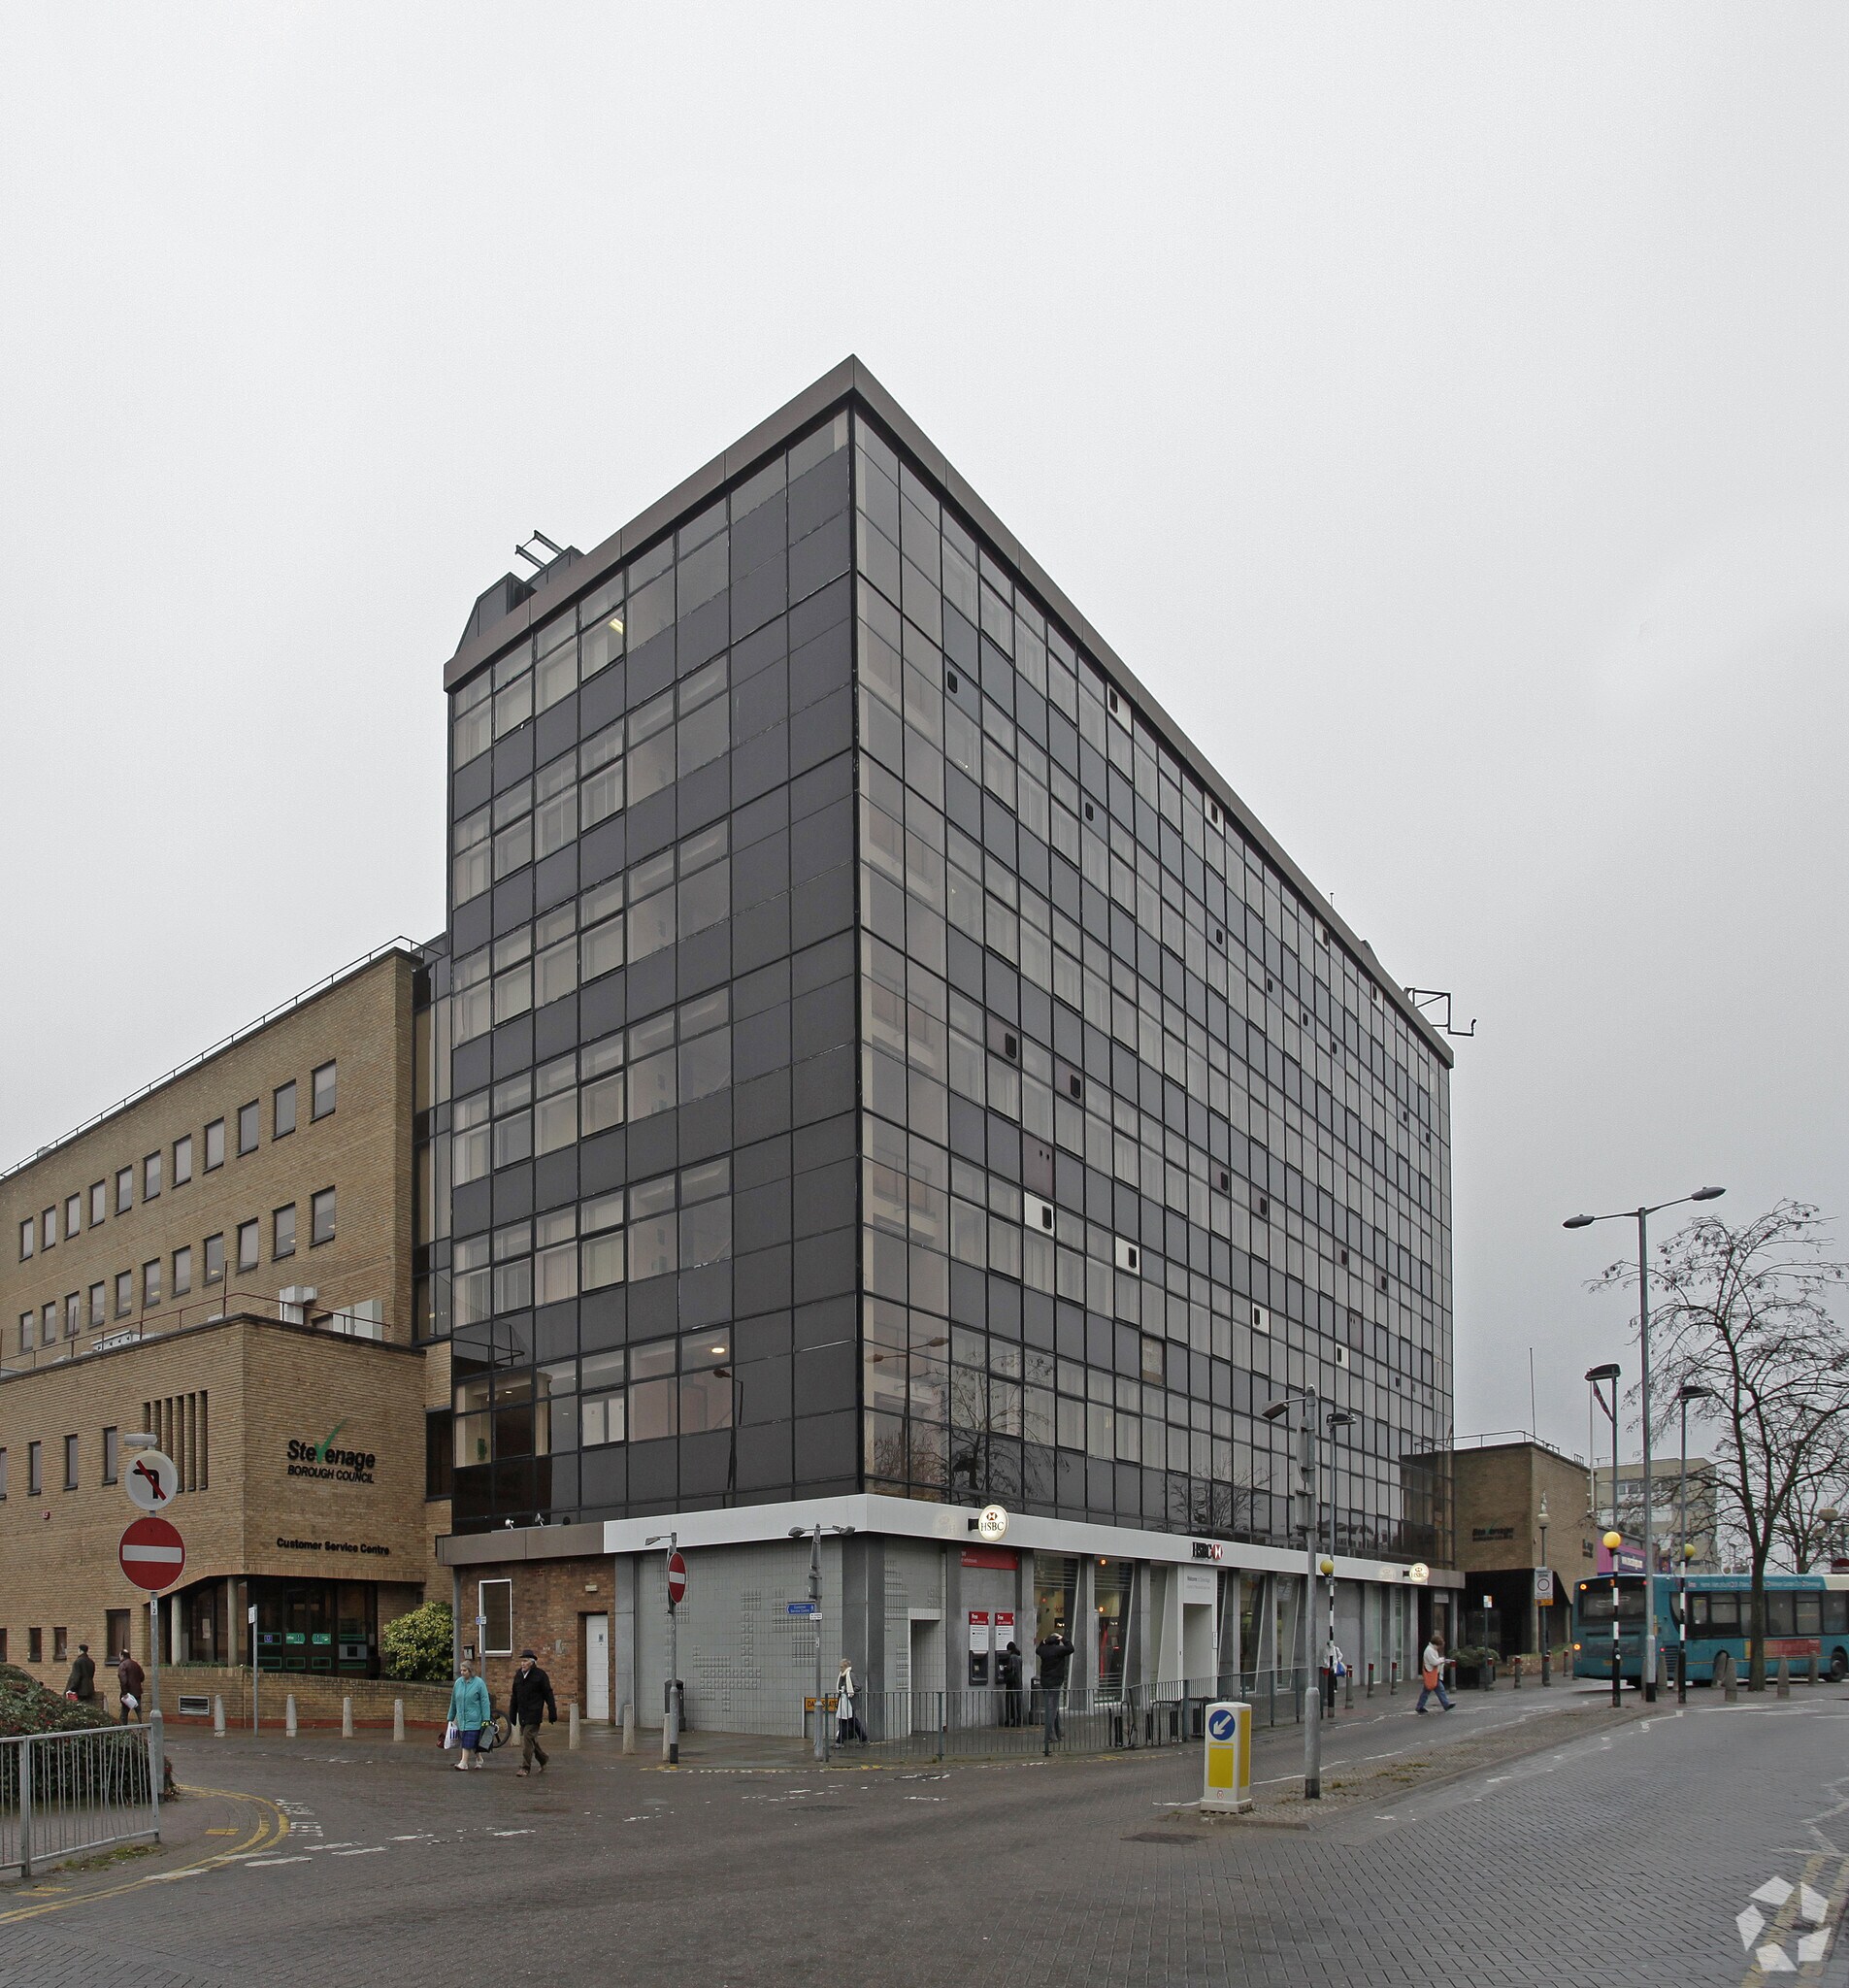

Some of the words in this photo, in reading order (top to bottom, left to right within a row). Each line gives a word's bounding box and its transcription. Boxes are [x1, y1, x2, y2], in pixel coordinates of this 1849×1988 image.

[287, 1419, 376, 1472] Stevenage
[287, 1464, 335, 1479] BOROUGH
[336, 1469, 375, 1484] COUNCIL
[980, 1521, 1004, 1532] HSBC
[277, 1538, 322, 1550] Customer
[324, 1541, 359, 1553] Service
[360, 1543, 390, 1555] Centre
[1192, 1541, 1212, 1559] HSBC
